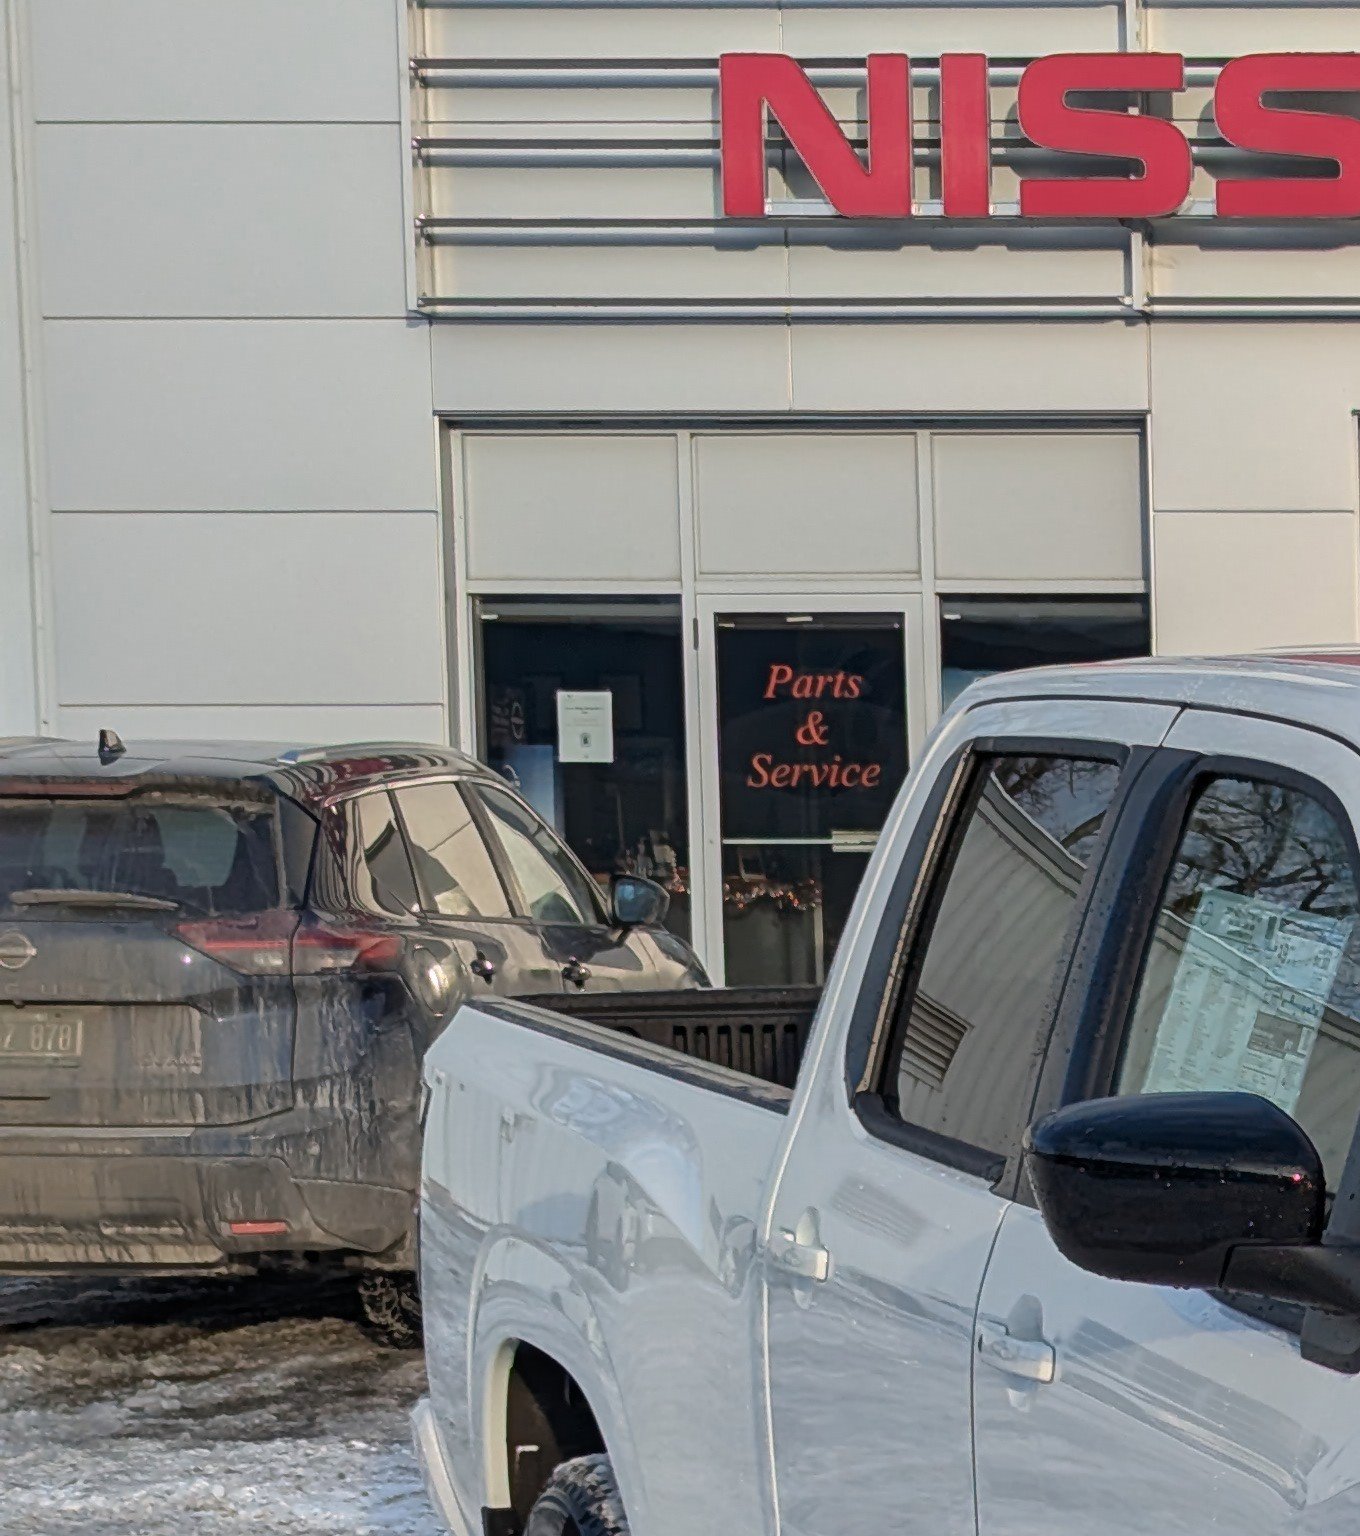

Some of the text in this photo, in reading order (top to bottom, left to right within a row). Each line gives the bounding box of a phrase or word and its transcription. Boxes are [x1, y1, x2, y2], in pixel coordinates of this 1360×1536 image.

[764, 664, 862, 699] Parts
[796, 711, 829, 746] &
[746, 754, 881, 789] Service
